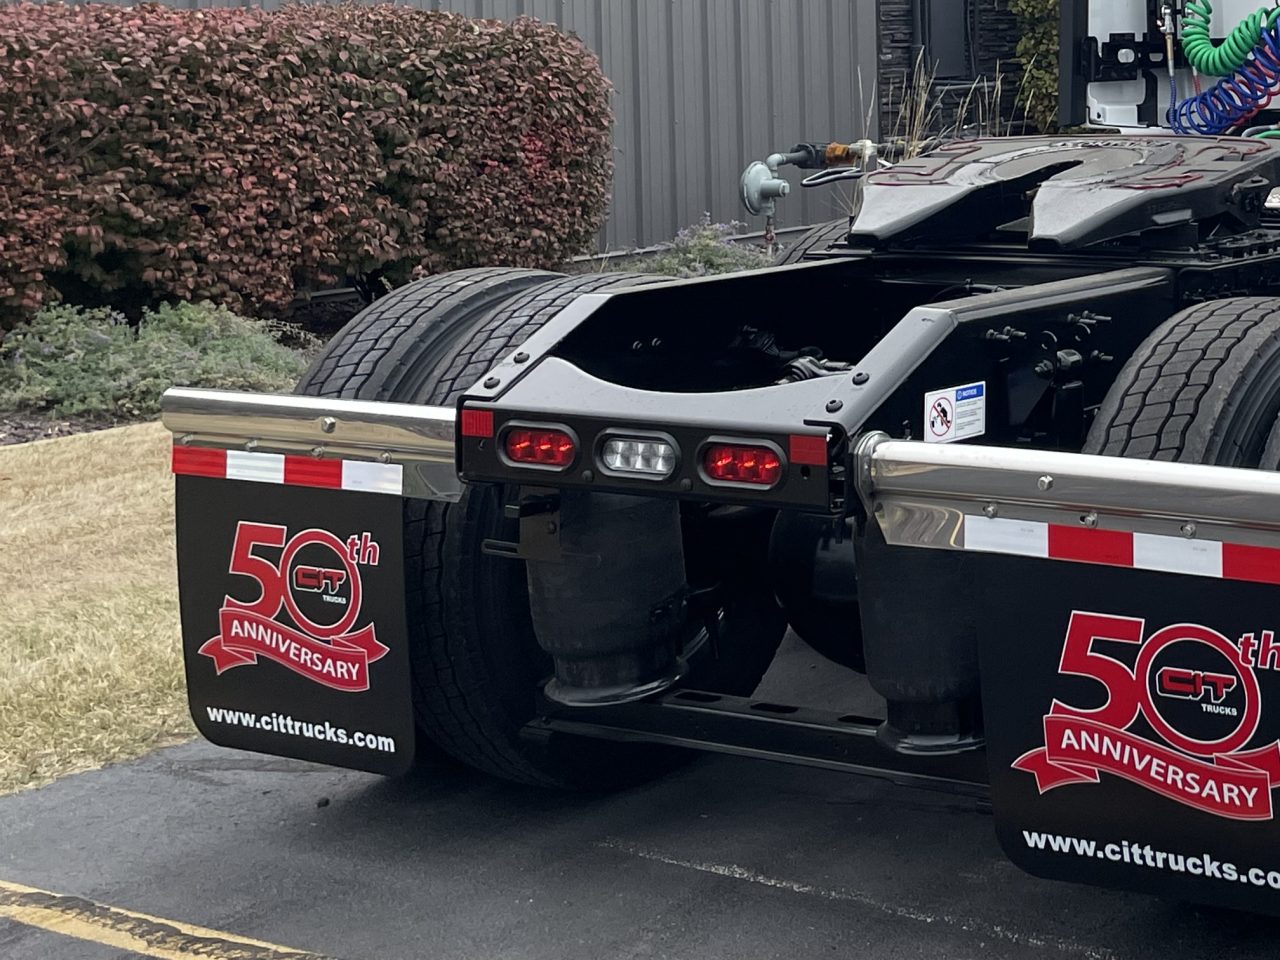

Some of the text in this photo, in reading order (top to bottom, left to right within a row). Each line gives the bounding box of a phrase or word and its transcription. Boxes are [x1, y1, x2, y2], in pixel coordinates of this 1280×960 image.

[293, 565, 347, 594] CIT
[322, 594, 347, 605] TRUCKS
[231, 620, 360, 681] ANNIVERSARY
[1156, 667, 1237, 703] CIT
[1201, 703, 1237, 716] TRUCKS
[206, 706, 395, 753] www.cittrucks.com
[1061, 729, 1258, 808] ANNIVERSARY
